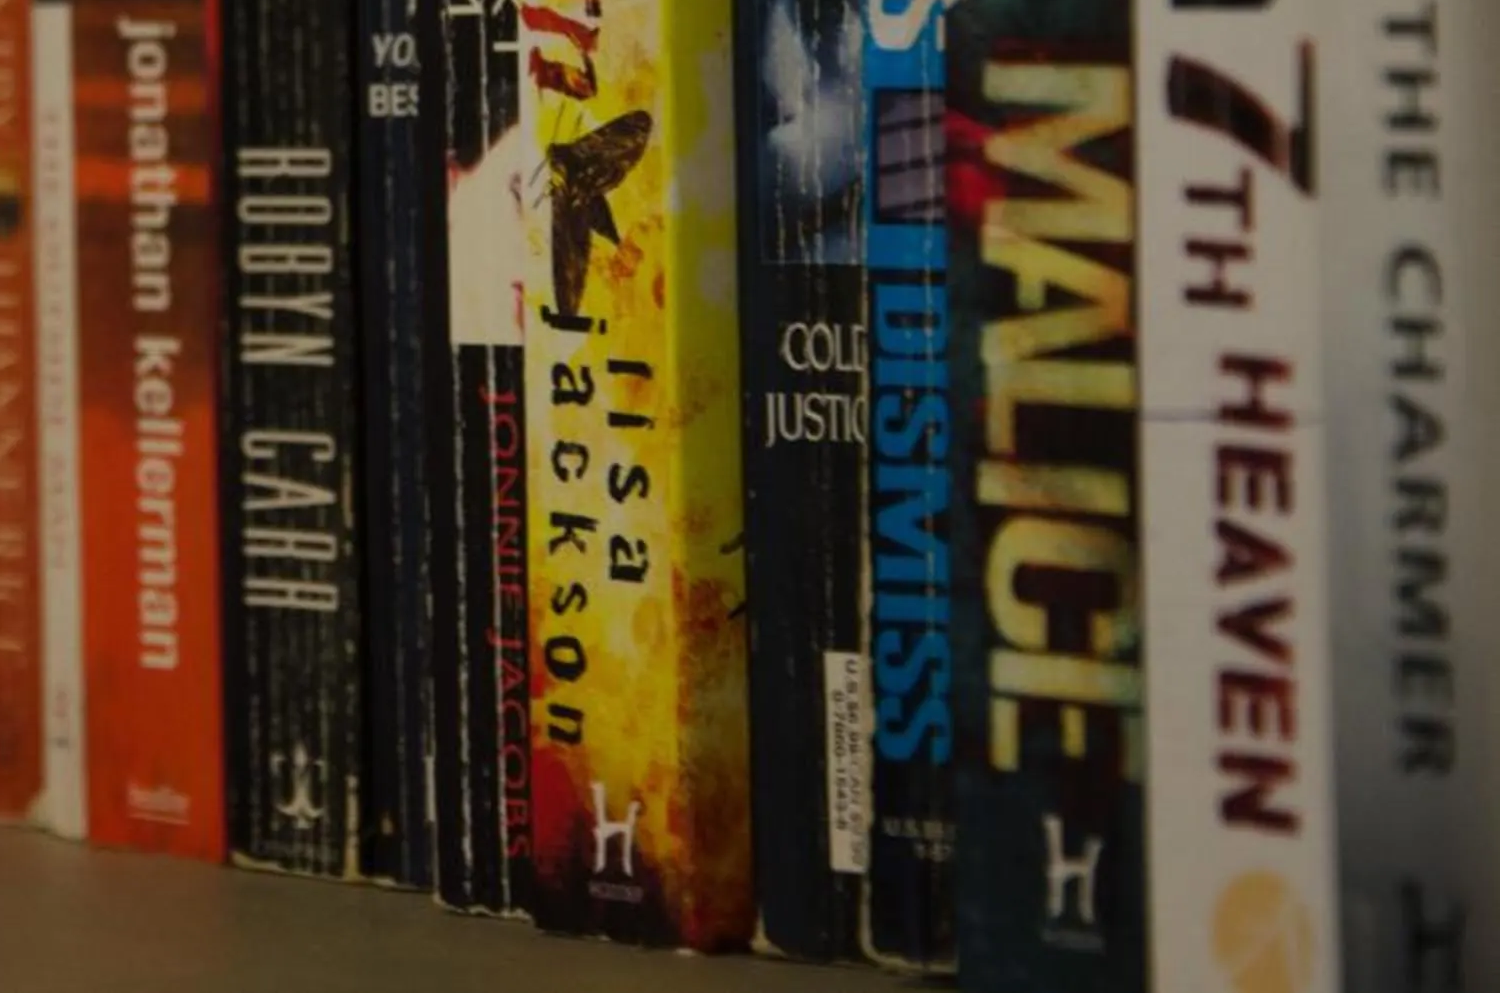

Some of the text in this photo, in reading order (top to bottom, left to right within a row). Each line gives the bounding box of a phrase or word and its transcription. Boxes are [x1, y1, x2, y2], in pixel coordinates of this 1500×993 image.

[1379, 0, 1442, 200] THE
[116, 11, 185, 671] jonathan kellerman
[236, 145, 341, 614] ROBYN CARR
[540, 305, 607, 746] jackson
[605, 357, 655, 584] lisa
[764, 390, 867, 449] JUSTIC
[780, 320, 866, 373] COLD
[976, 59, 1140, 784] MALICE
[1386, 242, 1457, 779] CHARMER
[478, 385, 531, 859] JONNIE JACOBS
[1214, 350, 1301, 839] HEAVEN
